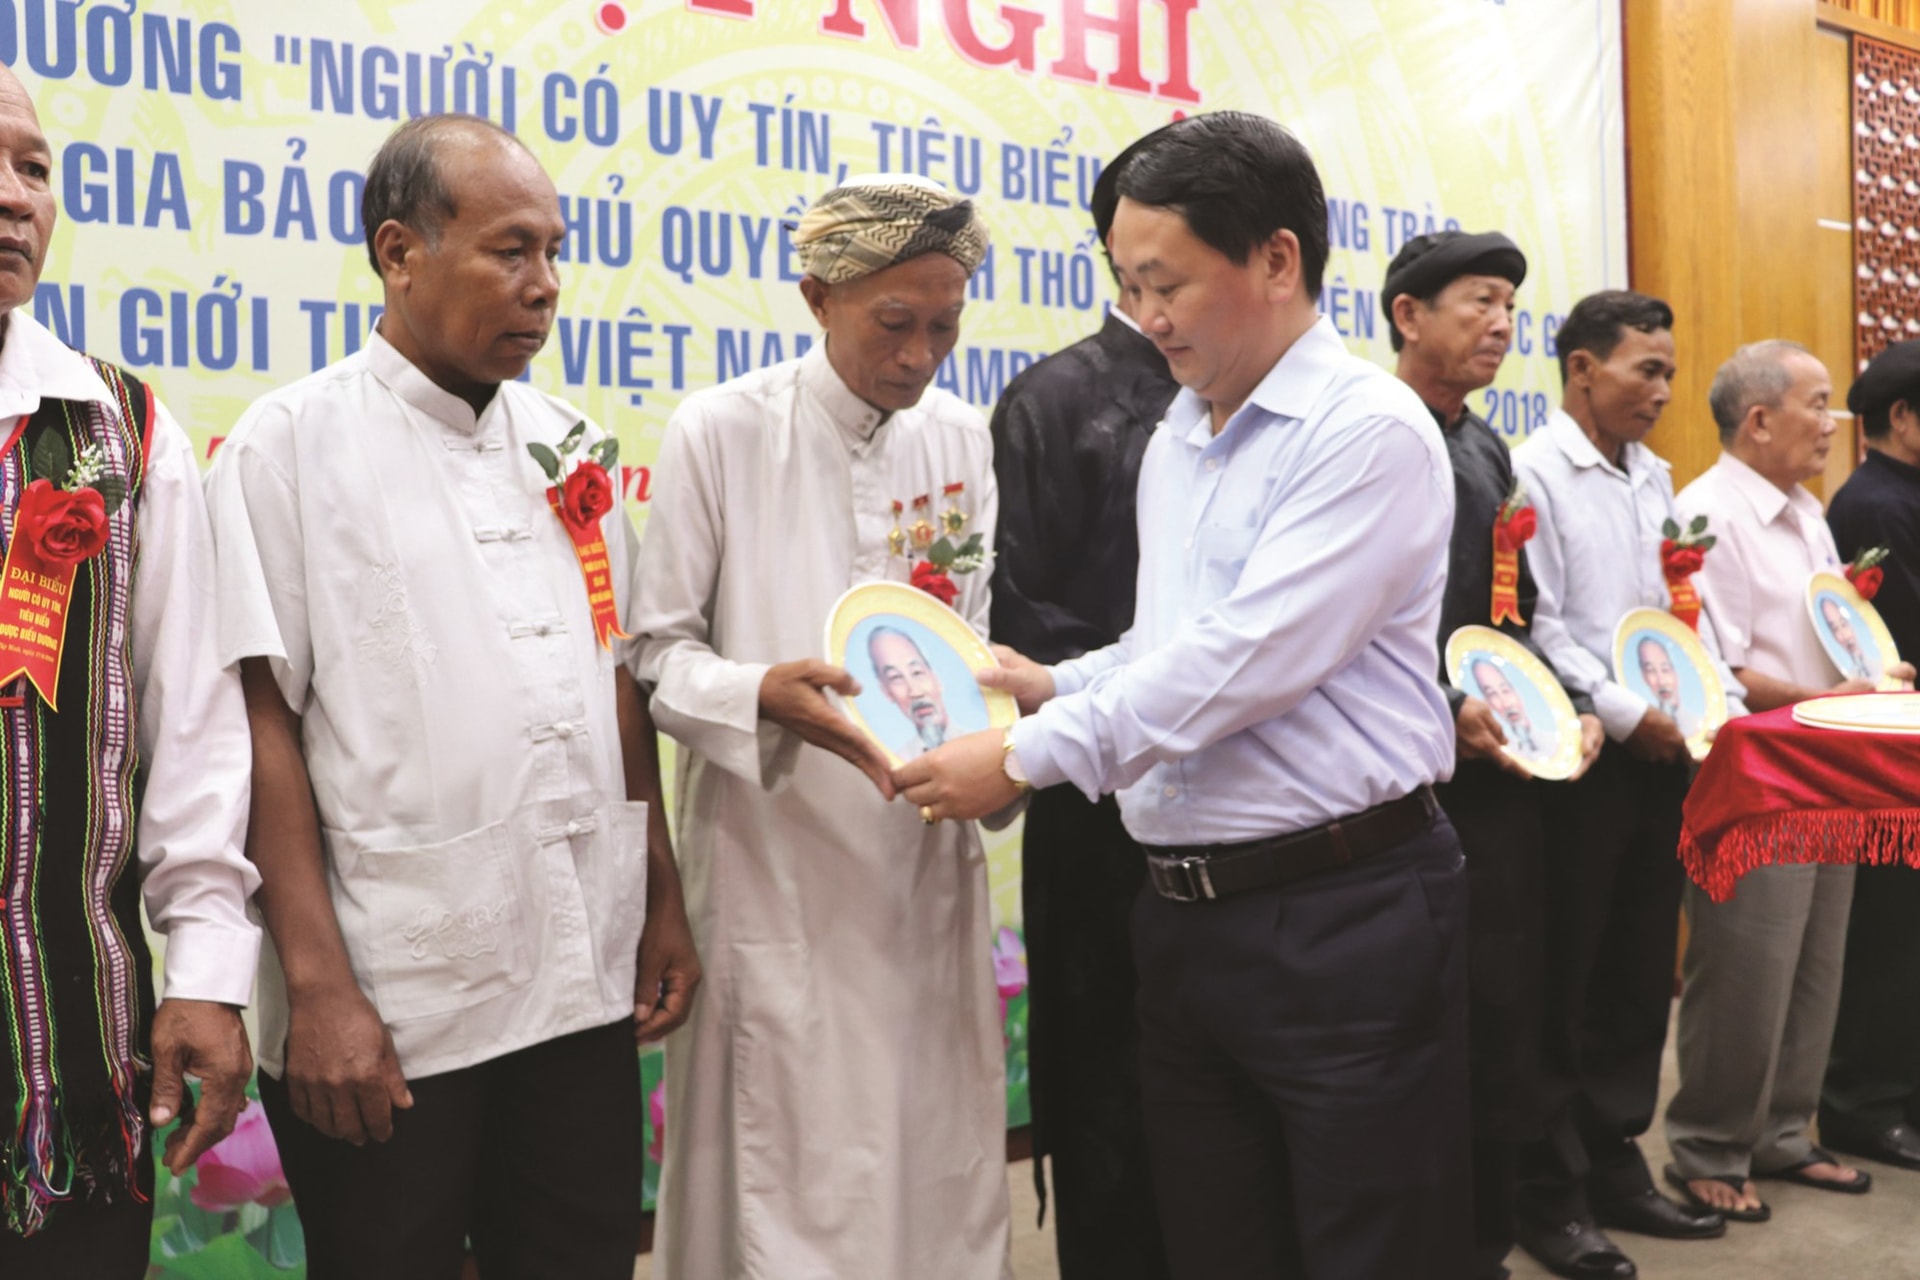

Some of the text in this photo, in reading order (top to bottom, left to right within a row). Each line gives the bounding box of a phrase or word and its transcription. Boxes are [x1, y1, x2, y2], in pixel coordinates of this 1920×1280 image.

[543, 64, 620, 147] CÓ
[648, 88, 722, 160] UY
[748, 93, 848, 188] TÍN,
[871, 117, 982, 196] TIÊU
[1001, 126, 1102, 212] BIỂU
[62, 141, 192, 231] GIA
[223, 137, 366, 245] BẢO
[557, 174, 632, 268] HỦ
[662, 195, 803, 284] QUYỀ
[119, 275, 269, 371] GIỚI
[558, 307, 692, 406] VIỆT
[1485, 389, 1547, 436] 2018
[10, 566, 67, 596] ĐẠI BIỂU
[20, 625, 37, 642] BIỂU
